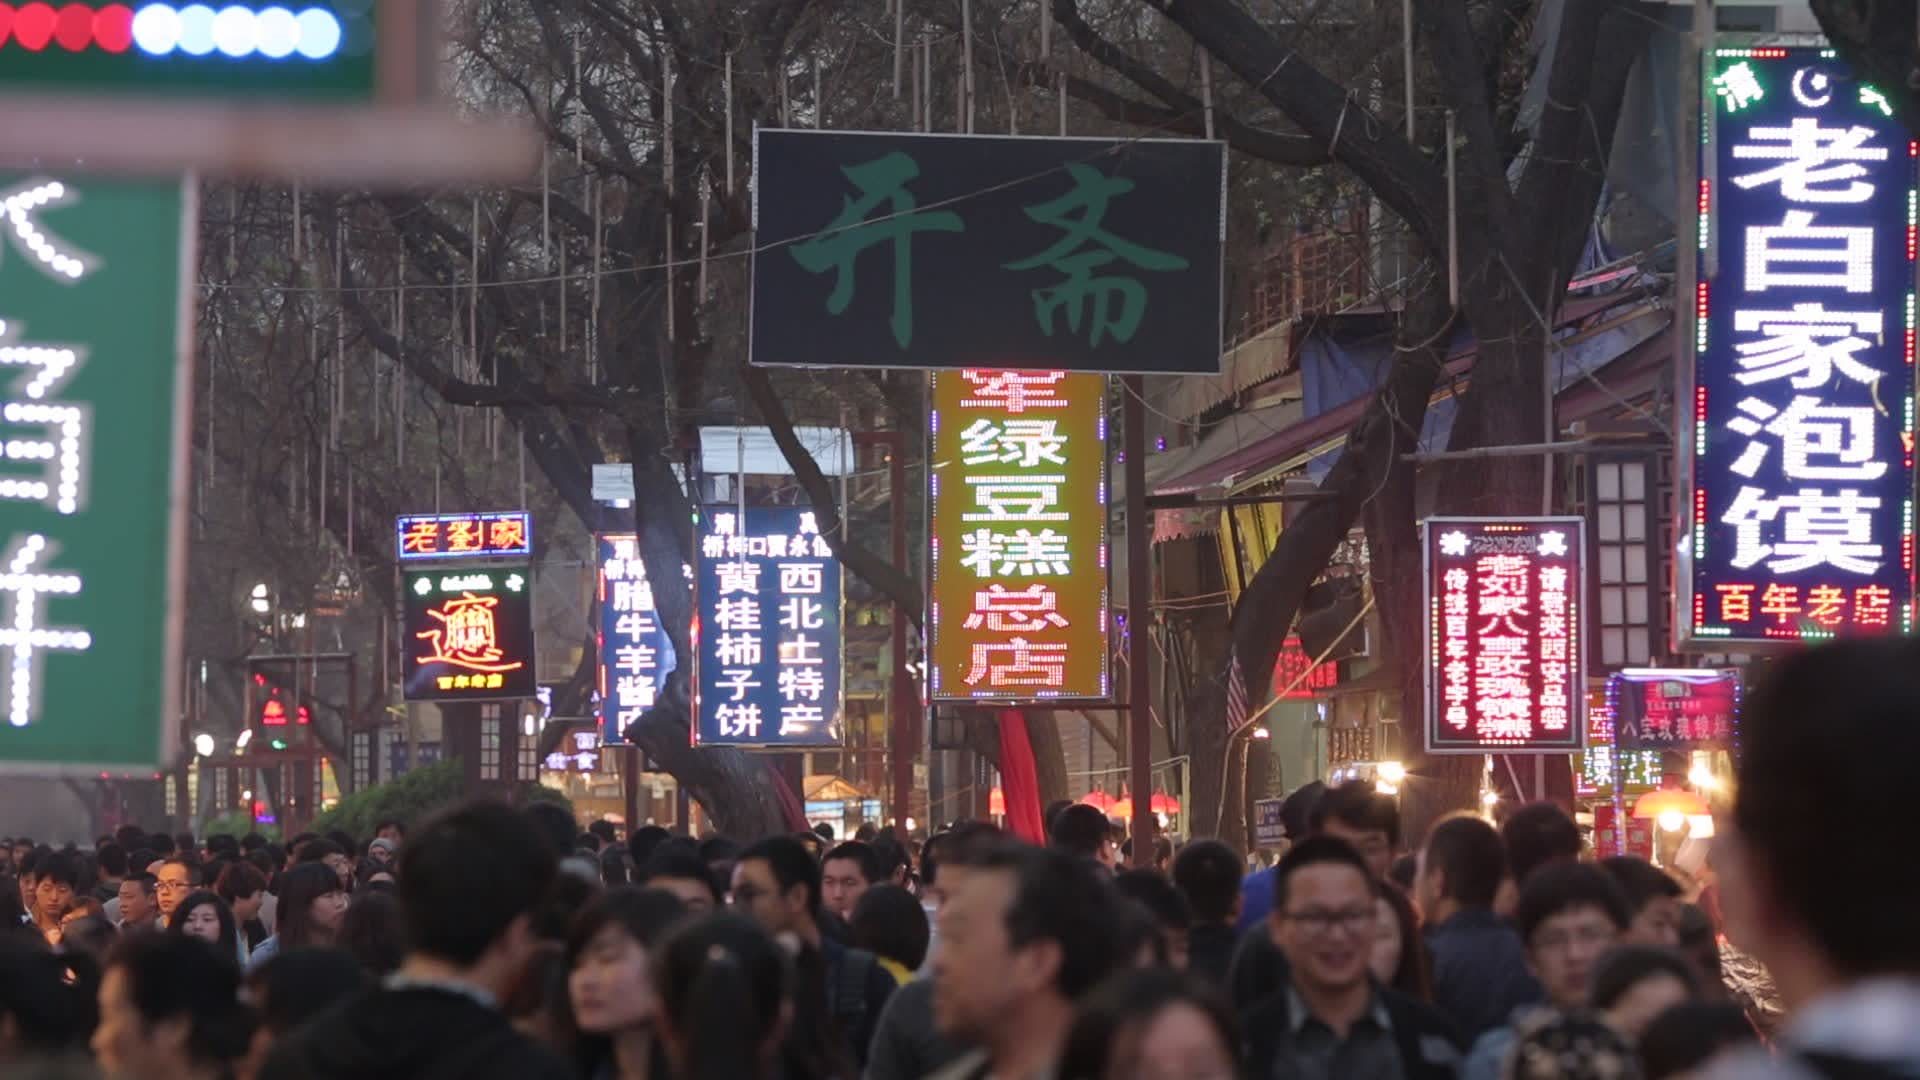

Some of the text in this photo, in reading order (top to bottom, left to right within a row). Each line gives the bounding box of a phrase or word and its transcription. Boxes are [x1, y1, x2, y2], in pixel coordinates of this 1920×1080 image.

[789, 151, 1190, 350] 开斋
[1721, 118, 1889, 575] 老白家泡馍
[1537, 530, 1568, 556] 真
[1714, 582, 1890, 625] 百年老店
[714, 561, 762, 737] 黄桂柿子饼
[777, 562, 824, 736] 西北土特产
